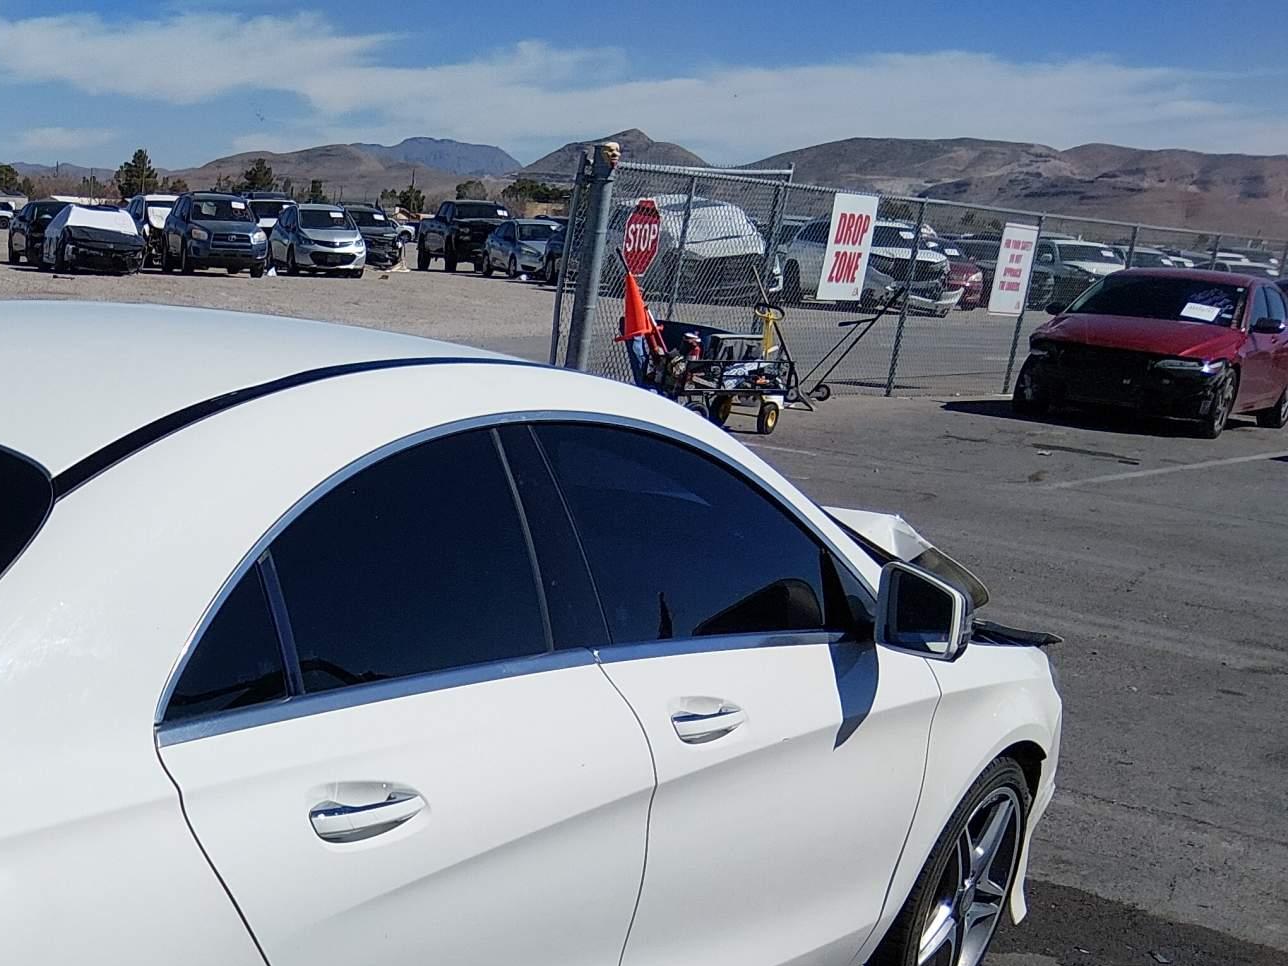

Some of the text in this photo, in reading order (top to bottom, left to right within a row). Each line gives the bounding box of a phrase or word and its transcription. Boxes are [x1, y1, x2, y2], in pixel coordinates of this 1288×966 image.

[626, 223, 658, 252] STOP
[834, 212, 871, 246] DROP
[827, 250, 863, 283] ZONE
